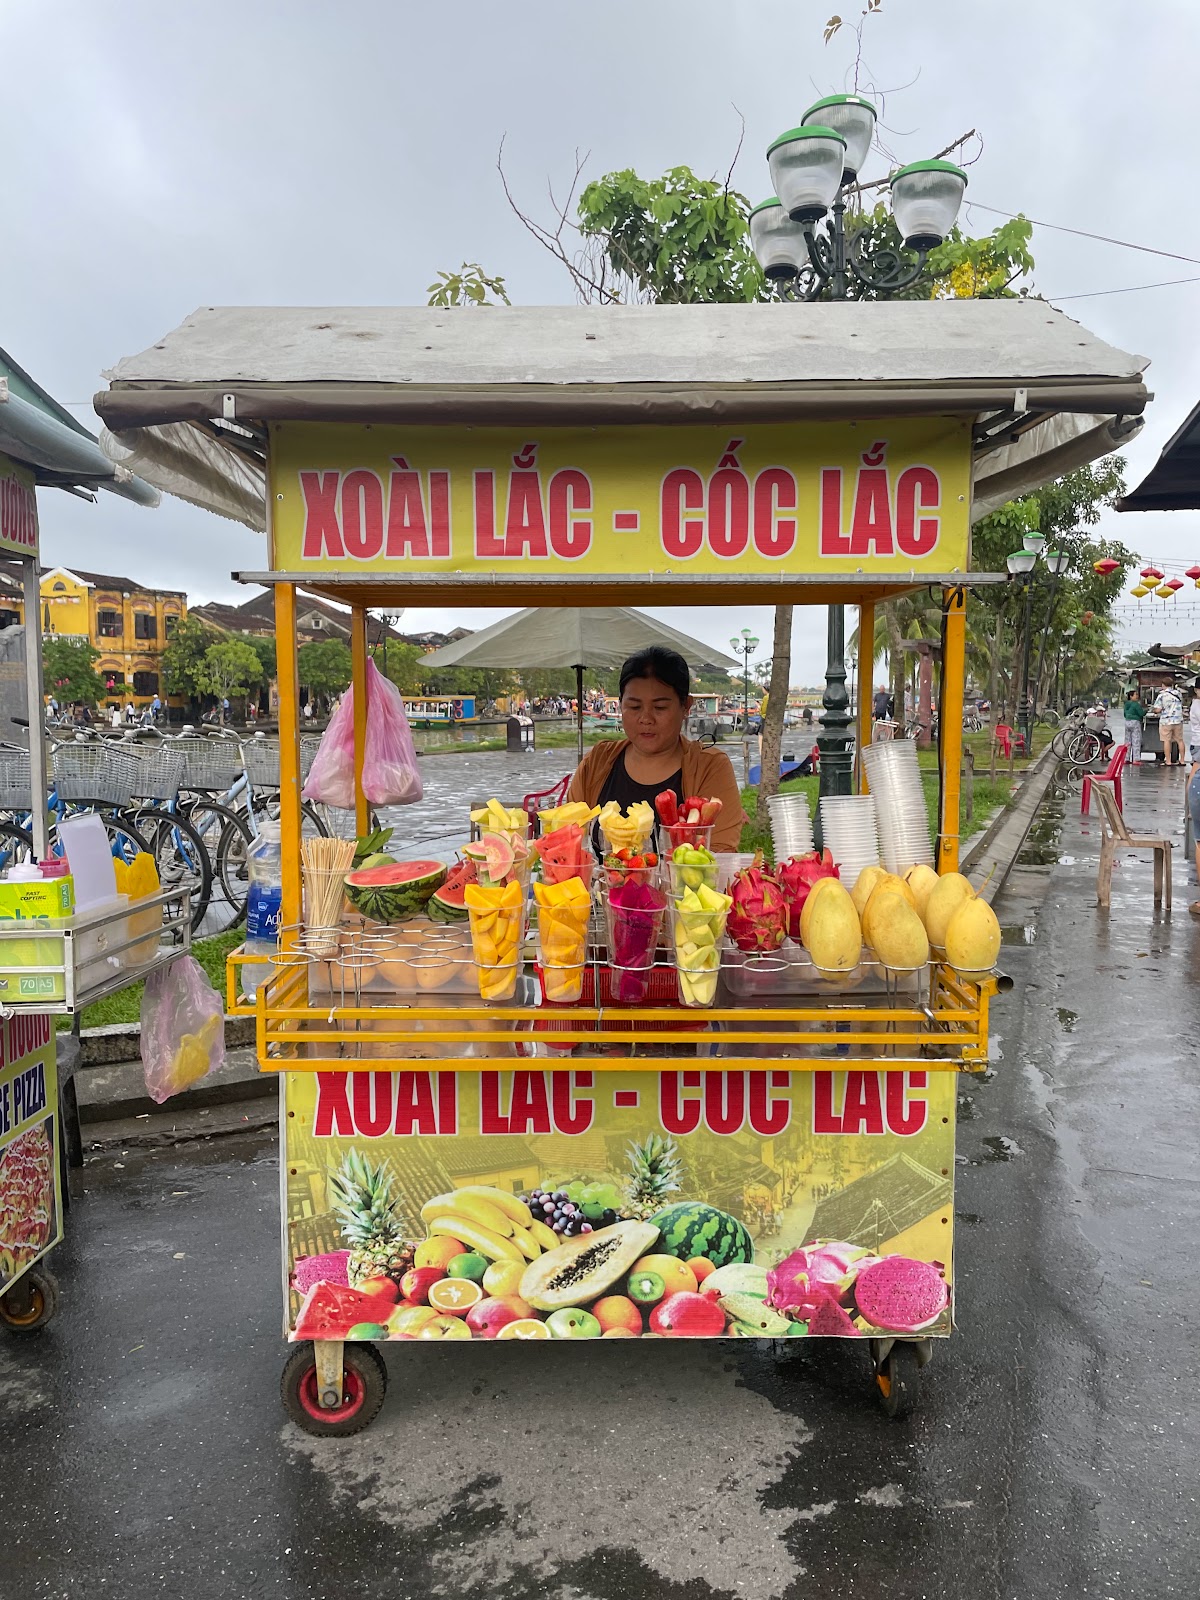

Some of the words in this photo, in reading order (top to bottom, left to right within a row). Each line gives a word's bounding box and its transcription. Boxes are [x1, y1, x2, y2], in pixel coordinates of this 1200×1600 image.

[299, 457, 450, 559] XOÀI
[474, 444, 592, 559] LẮC
[660, 440, 797, 558] CỐC
[820, 441, 940, 556] LẮC
[21, 979, 35, 989] 70
[39, 978, 53, 988] A5
[13, 1062, 46, 1127] PIZZA
